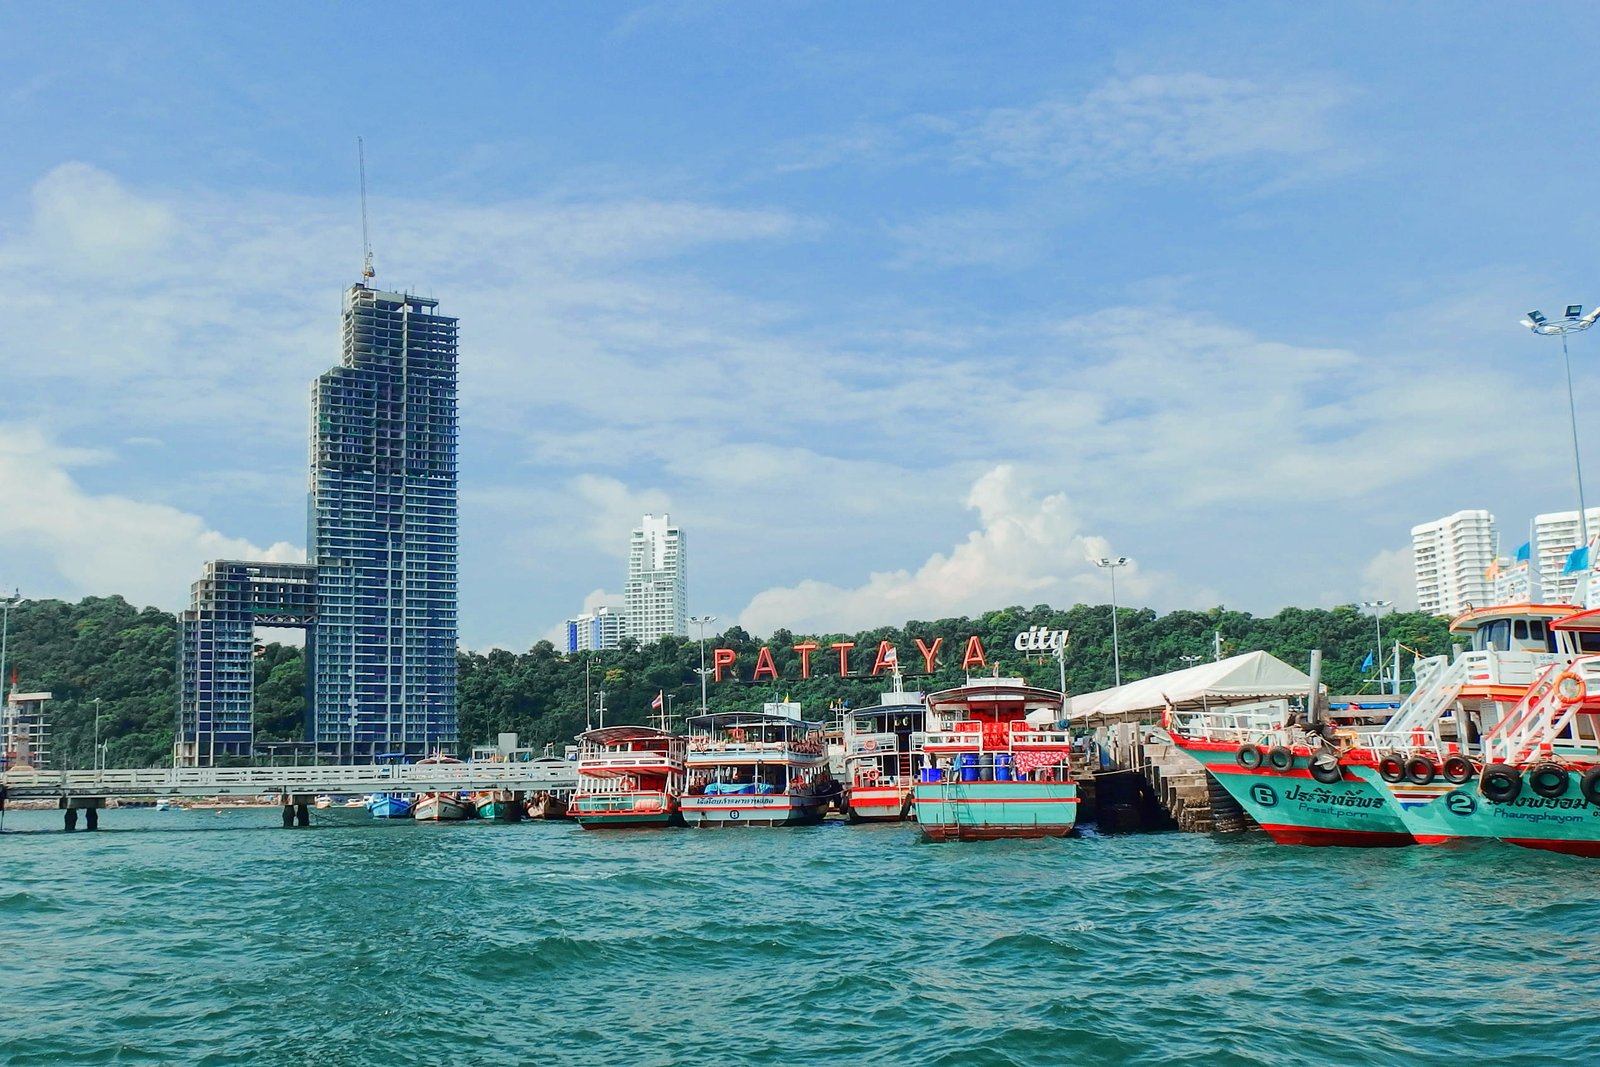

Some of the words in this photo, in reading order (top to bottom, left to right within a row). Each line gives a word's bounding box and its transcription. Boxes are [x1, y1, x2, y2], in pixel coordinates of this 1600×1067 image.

[714, 636, 986, 682] PATTAYA
[1015, 626, 1069, 656] city
[1450, 794, 1472, 813] 2
